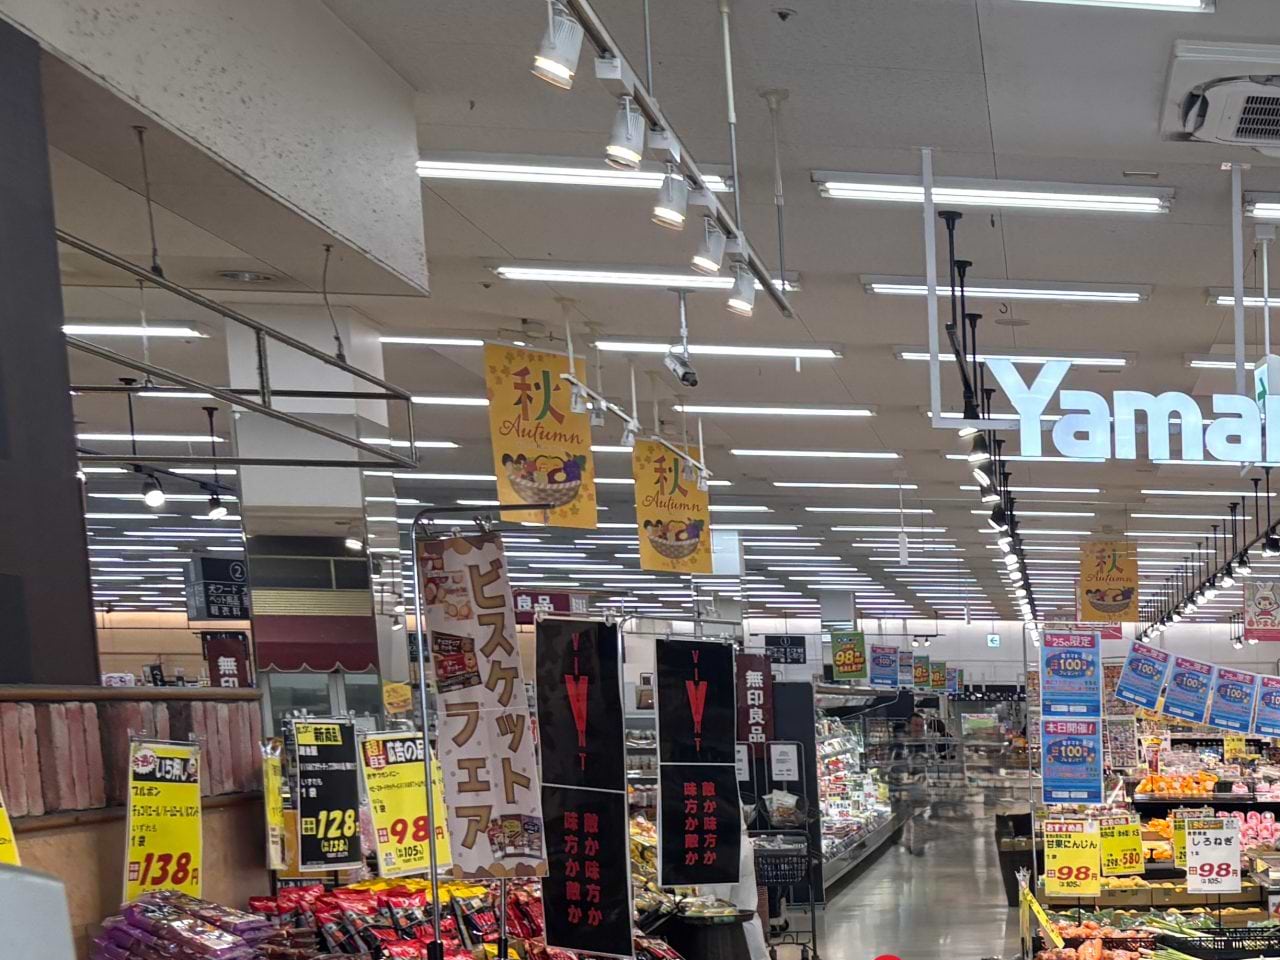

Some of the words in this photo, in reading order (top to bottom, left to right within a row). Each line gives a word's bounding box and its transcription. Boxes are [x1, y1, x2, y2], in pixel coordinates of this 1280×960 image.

[512, 366, 565, 424] 秋
[500, 415, 583, 448] Autumn
[654, 455, 688, 497] 秋
[642, 494, 702, 513] Autumn
[1085, 573, 1133, 584] Autumn
[1096, 549, 1123, 574] 秋
[468, 558, 531, 805] ビスケット
[1060, 659, 1081, 670] 100
[745, 670, 766, 743] 無印良品
[369, 756, 386, 768] 目玉
[1061, 746, 1082, 757] 100
[683, 782, 699, 866] 味方か敵か
[702, 781, 718, 866] 敵か味方か
[1192, 836, 1234, 846] しろねぎ
[563, 811, 582, 924] 味方か敵か
[583, 812, 603, 927] 敵か味方か
